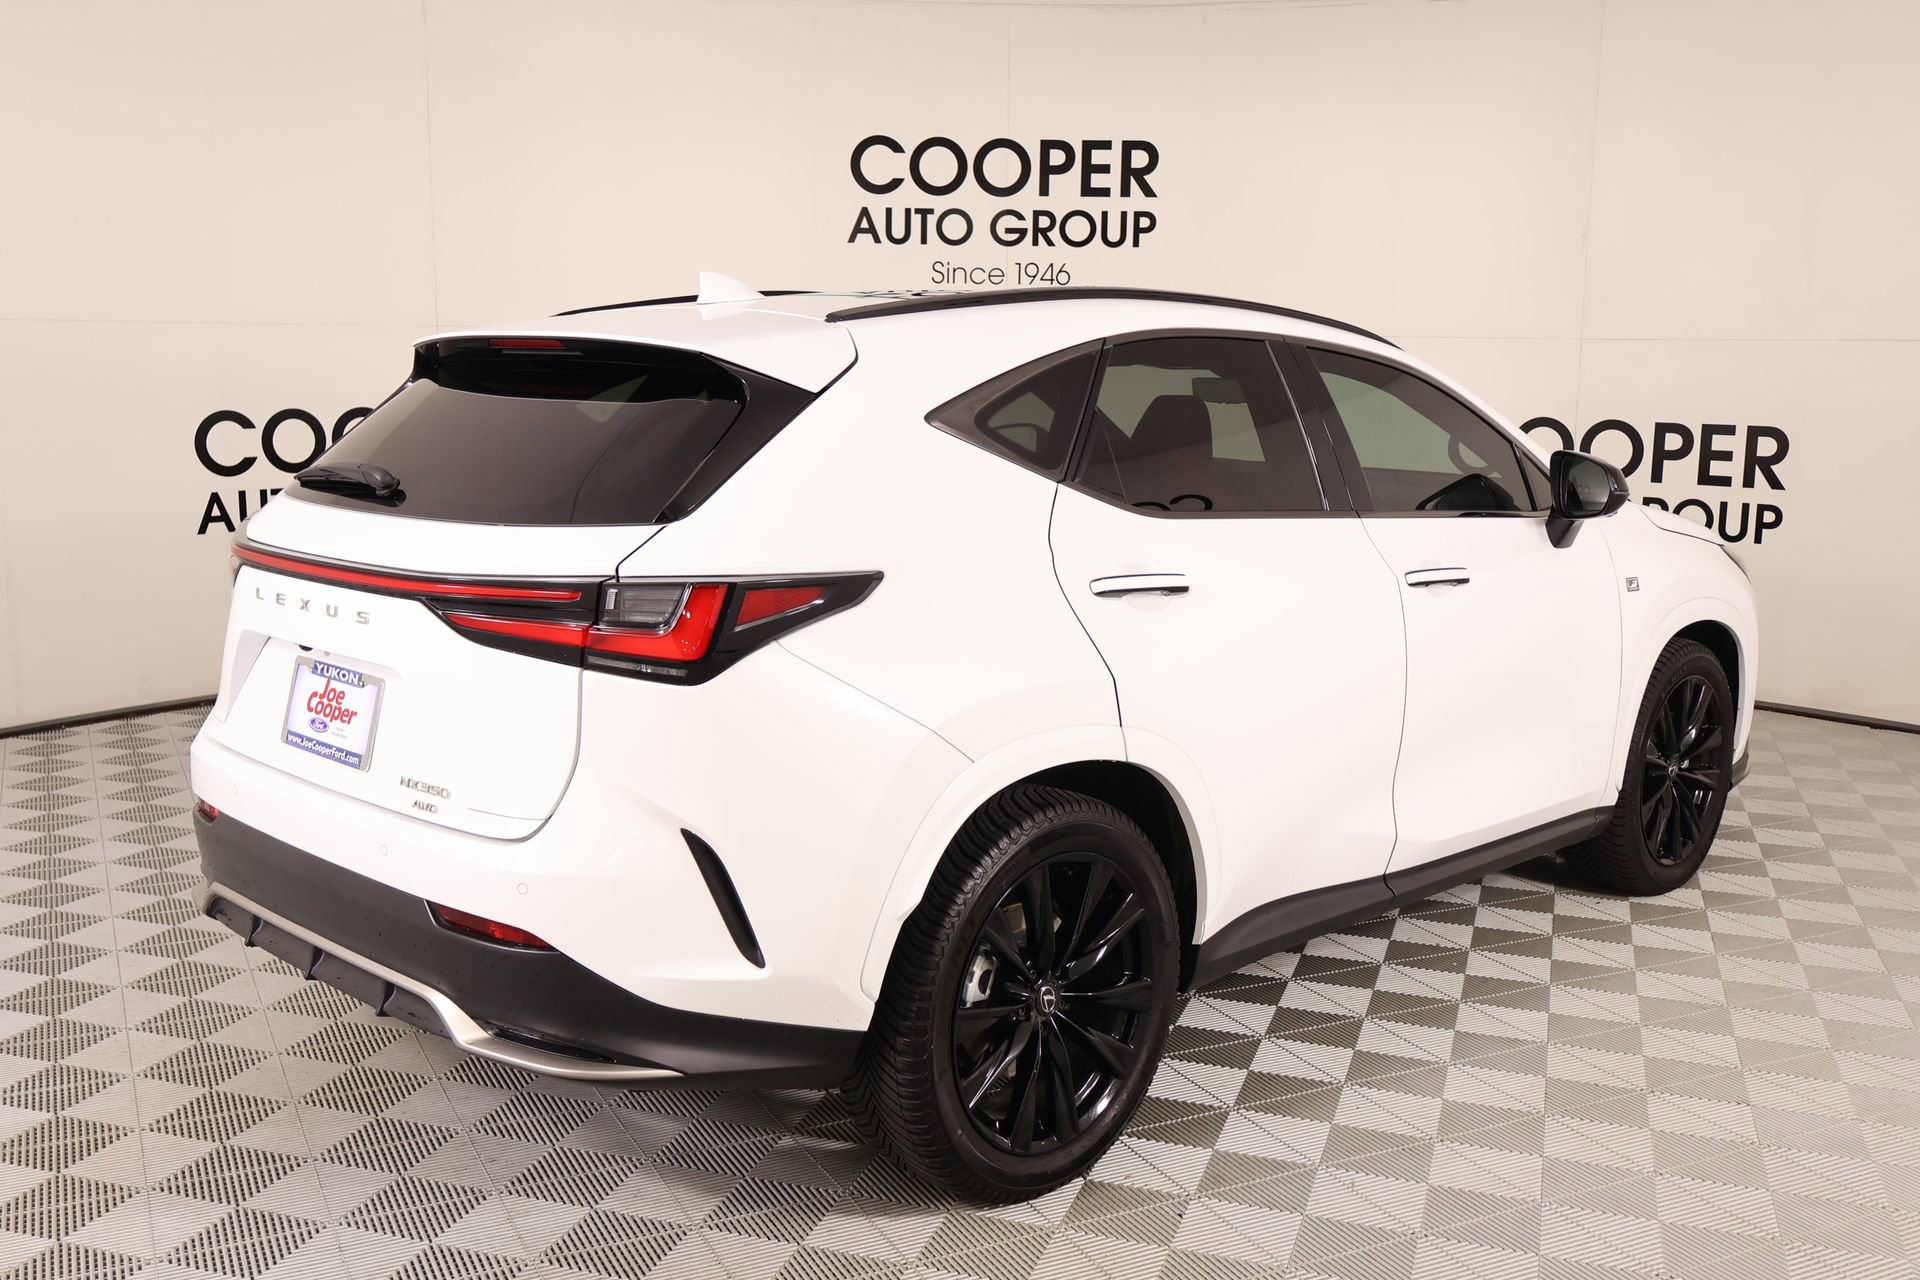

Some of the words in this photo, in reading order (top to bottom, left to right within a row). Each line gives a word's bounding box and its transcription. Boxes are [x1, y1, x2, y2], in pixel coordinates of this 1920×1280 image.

[850, 135, 1159, 198] COOPER
[847, 206, 974, 246] AUTO
[990, 209, 1157, 248] GROUP
[931, 261, 1005, 285] Since
[1014, 262, 1071, 286] 1946
[256, 587, 370, 625] LEXUS
[315, 663, 359, 685] YUKON
[319, 677, 345, 705] Joe
[307, 691, 357, 725] Cooper
[287, 734, 359, 765] www.JoeCooperFord.com
